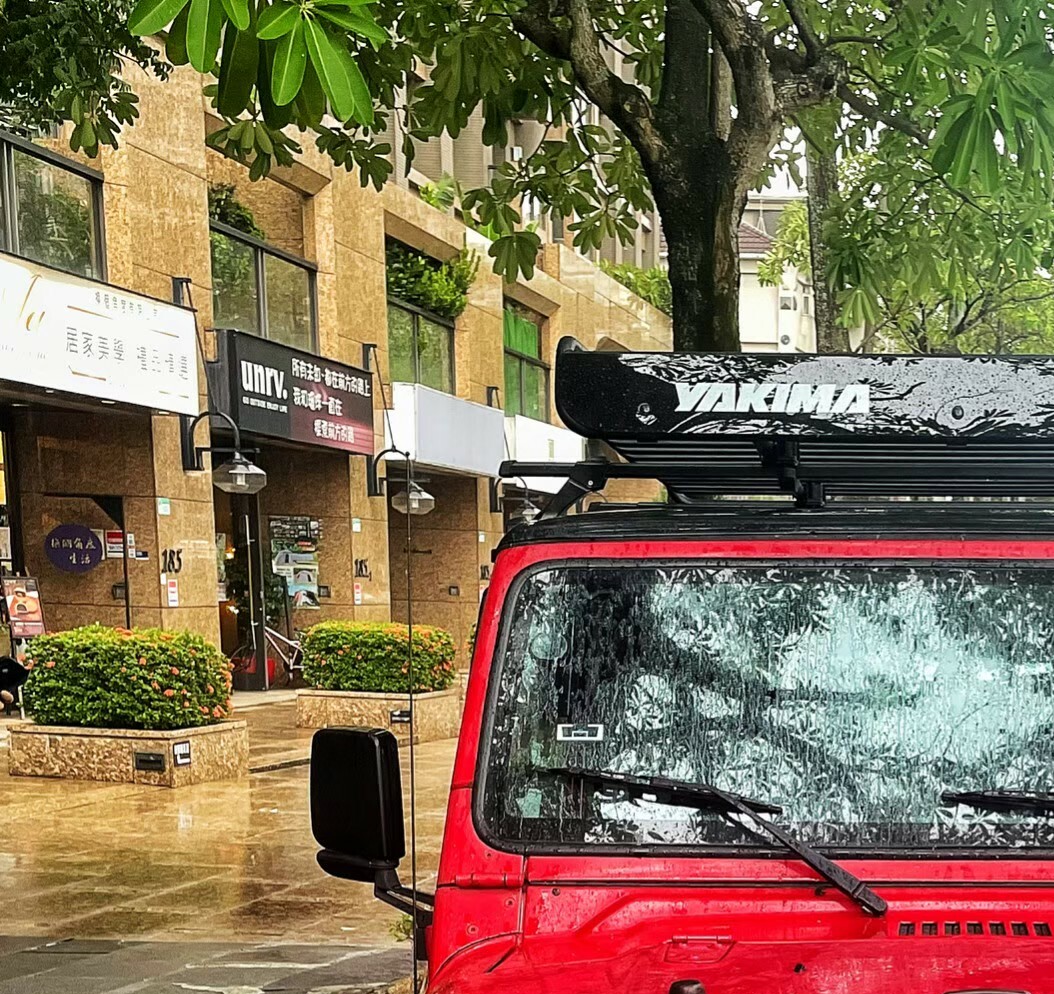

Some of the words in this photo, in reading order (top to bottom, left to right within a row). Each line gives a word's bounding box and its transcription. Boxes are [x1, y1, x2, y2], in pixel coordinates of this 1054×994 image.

[240, 360, 288, 400] unrv.
[674, 382, 871, 414] YAKIMA
[161, 548, 182, 574] 185
